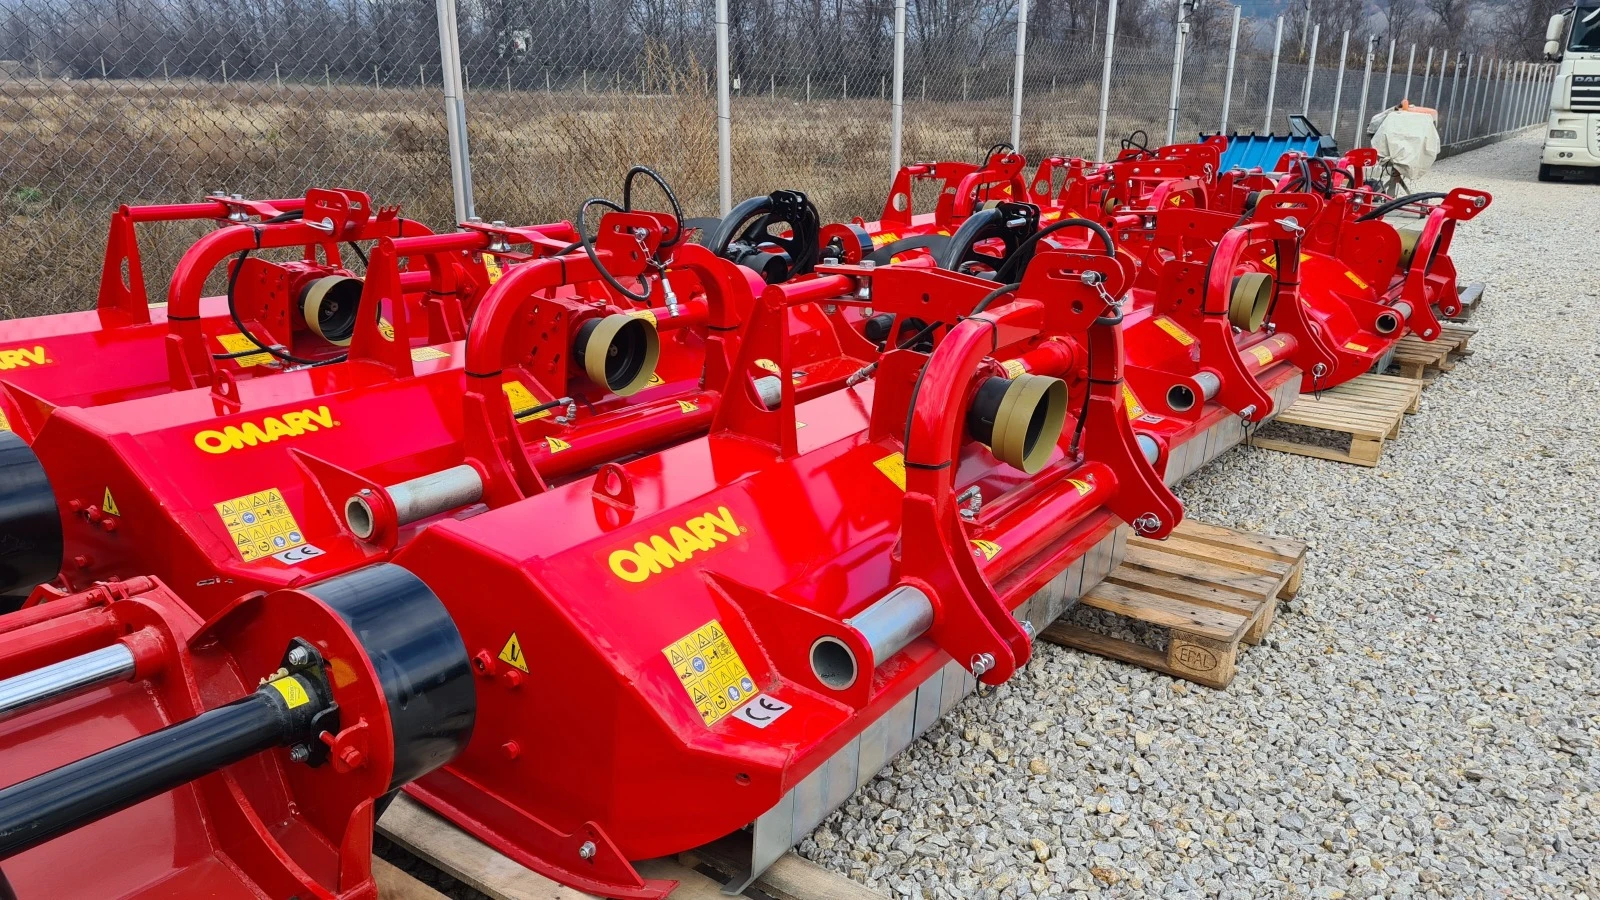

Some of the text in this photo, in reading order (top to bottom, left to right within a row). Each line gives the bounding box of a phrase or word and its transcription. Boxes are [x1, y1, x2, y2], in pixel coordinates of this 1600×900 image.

[194, 405, 334, 454] OMARV
[608, 505, 741, 583] OMARV
[1179, 647, 1210, 669] EPAL
